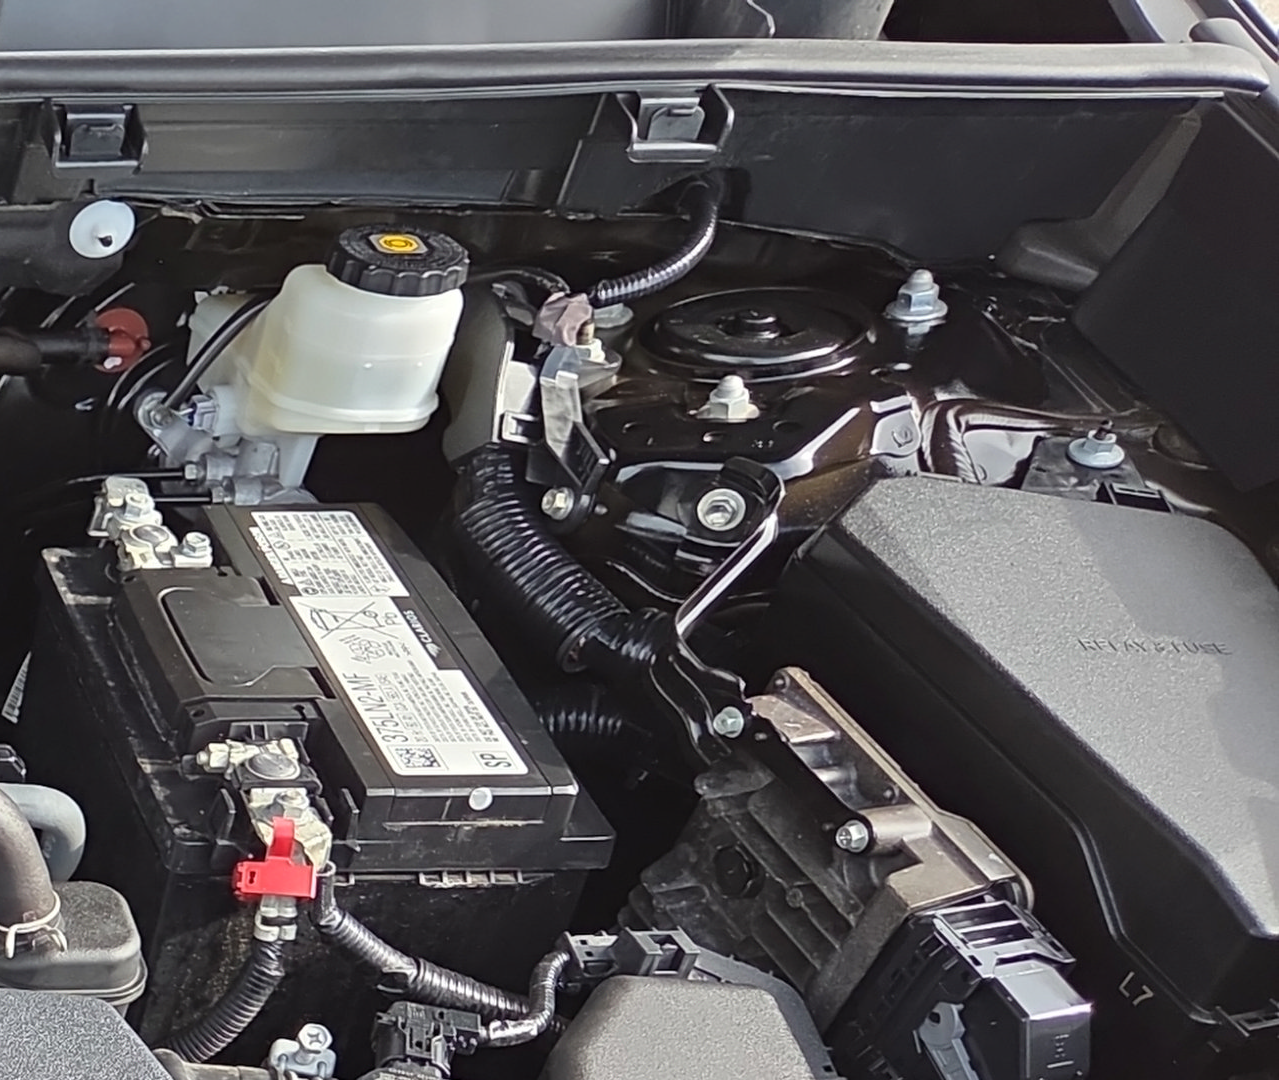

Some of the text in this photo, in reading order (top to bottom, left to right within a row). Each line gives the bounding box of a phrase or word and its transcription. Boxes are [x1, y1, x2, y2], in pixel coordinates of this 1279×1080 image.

[403, 609, 432, 643] CLARIOS
[342, 673, 409, 743] 375LN2-MF
[479, 752, 513, 768] SP
[1119, 971, 1154, 1007] L7
